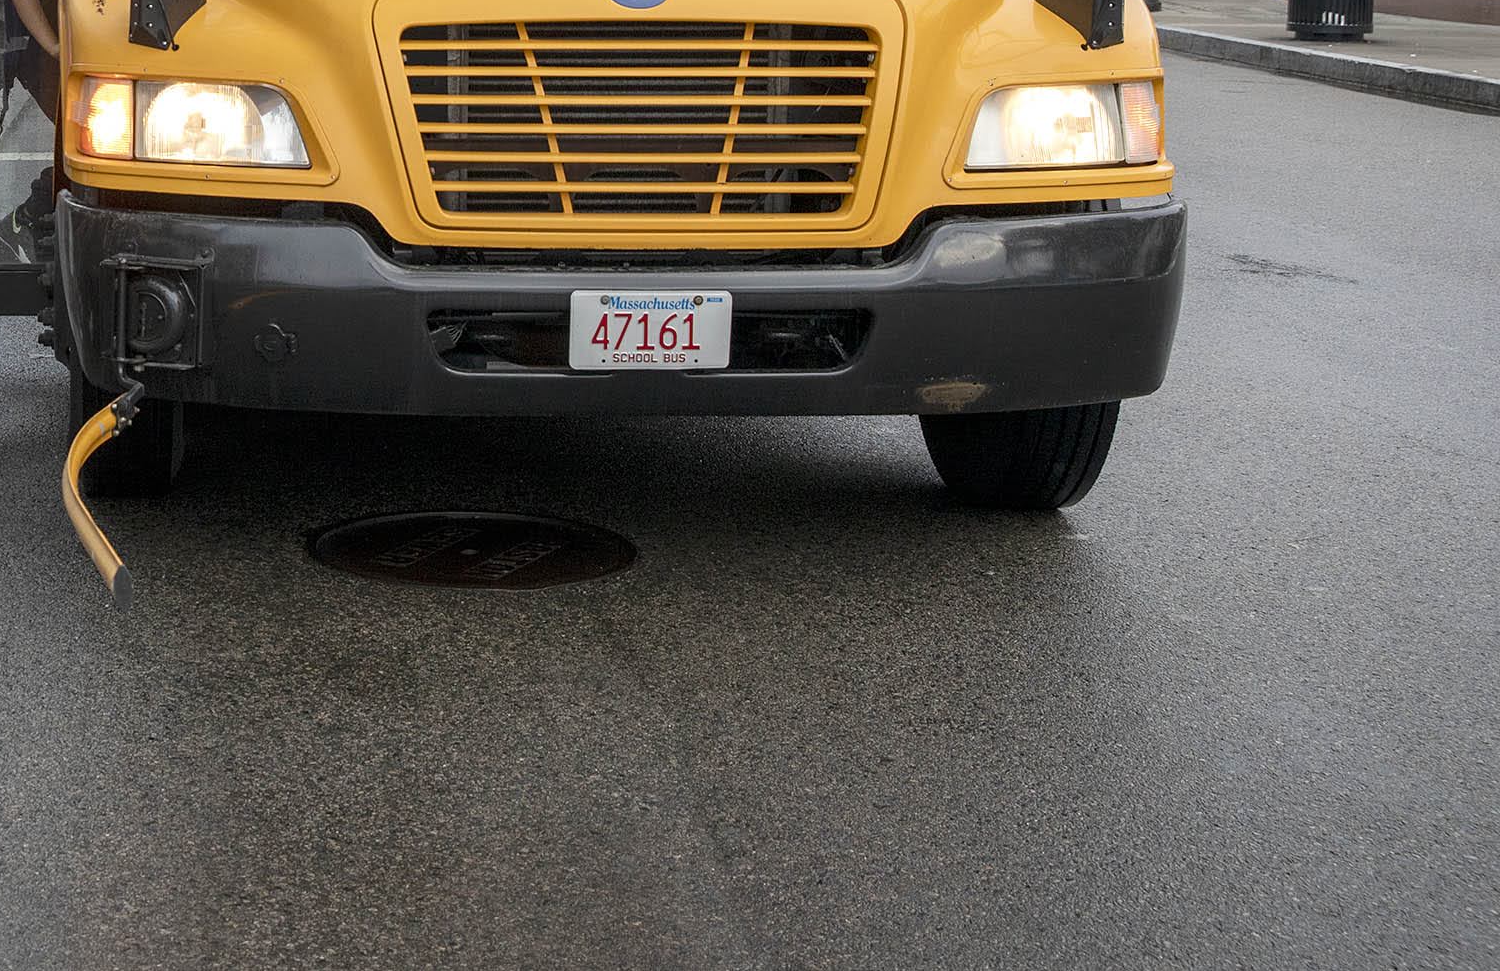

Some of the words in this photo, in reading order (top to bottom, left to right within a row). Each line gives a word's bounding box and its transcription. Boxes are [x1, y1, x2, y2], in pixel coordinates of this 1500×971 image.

[609, 296, 696, 310] Massachusetts
[591, 313, 701, 350] 47161
[612, 353, 658, 363] SCHOOL
[663, 353, 686, 363] BUS
